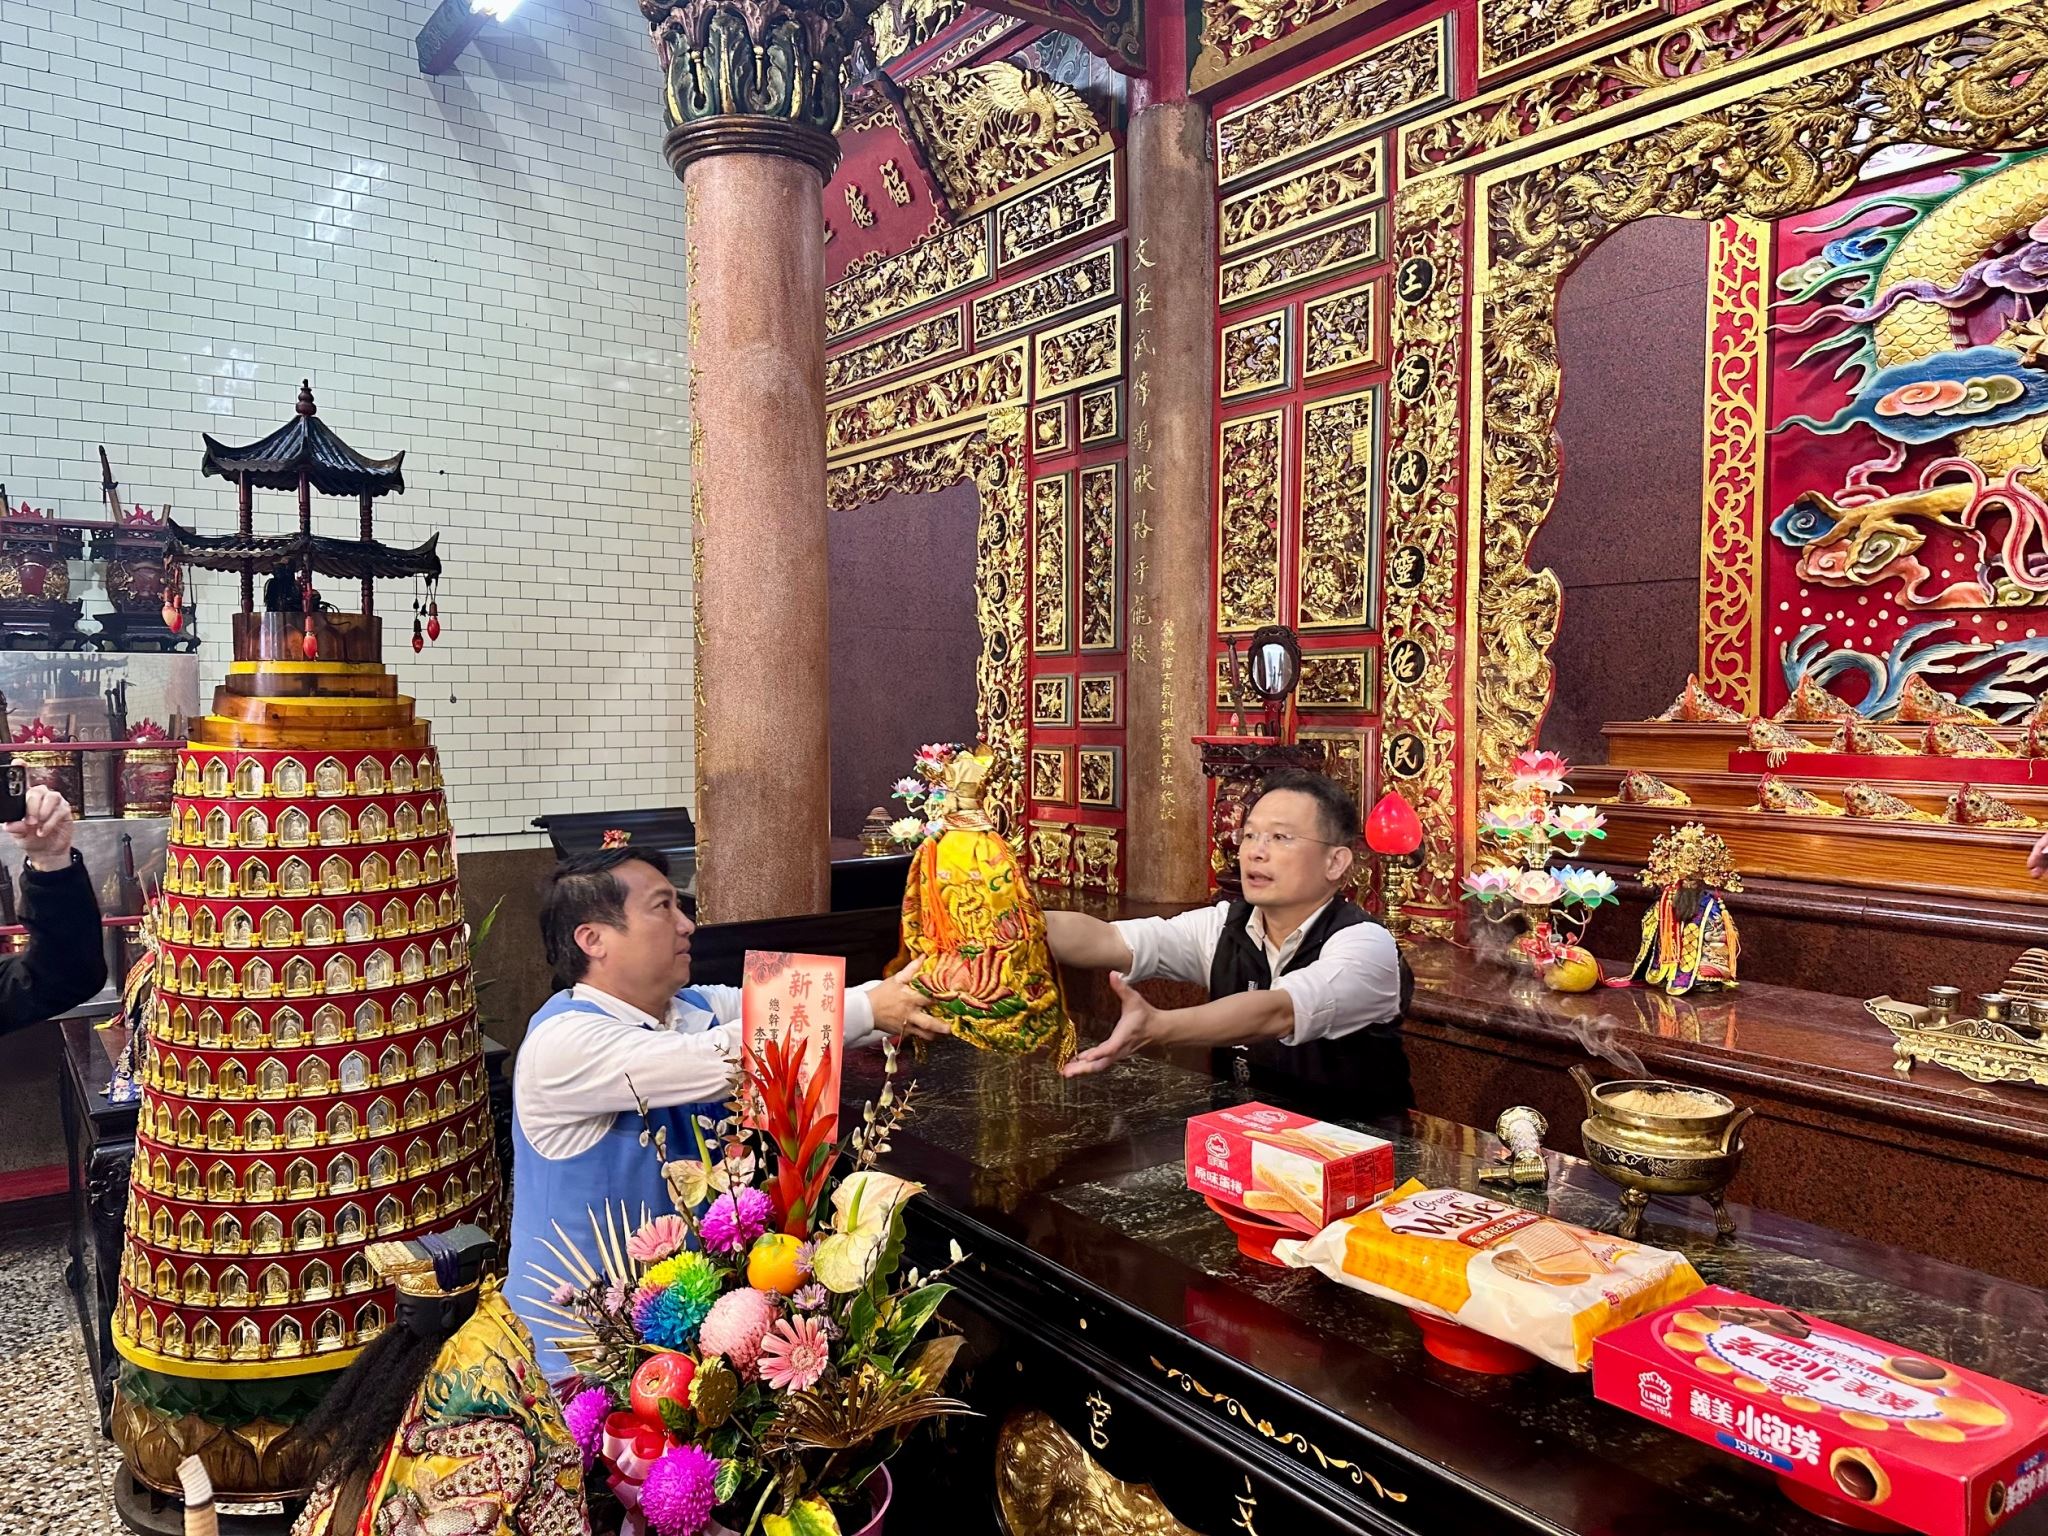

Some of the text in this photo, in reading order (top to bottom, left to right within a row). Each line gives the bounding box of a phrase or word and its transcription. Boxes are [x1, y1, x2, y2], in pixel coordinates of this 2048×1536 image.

[820, 971, 836, 1013] 恭祝
[1413, 1190, 1460, 1212] Cream
[1391, 1200, 1514, 1235] Wafe
[1824, 1357, 1891, 1385] CHOCO
[1734, 1438, 1773, 1463] 巧克力
